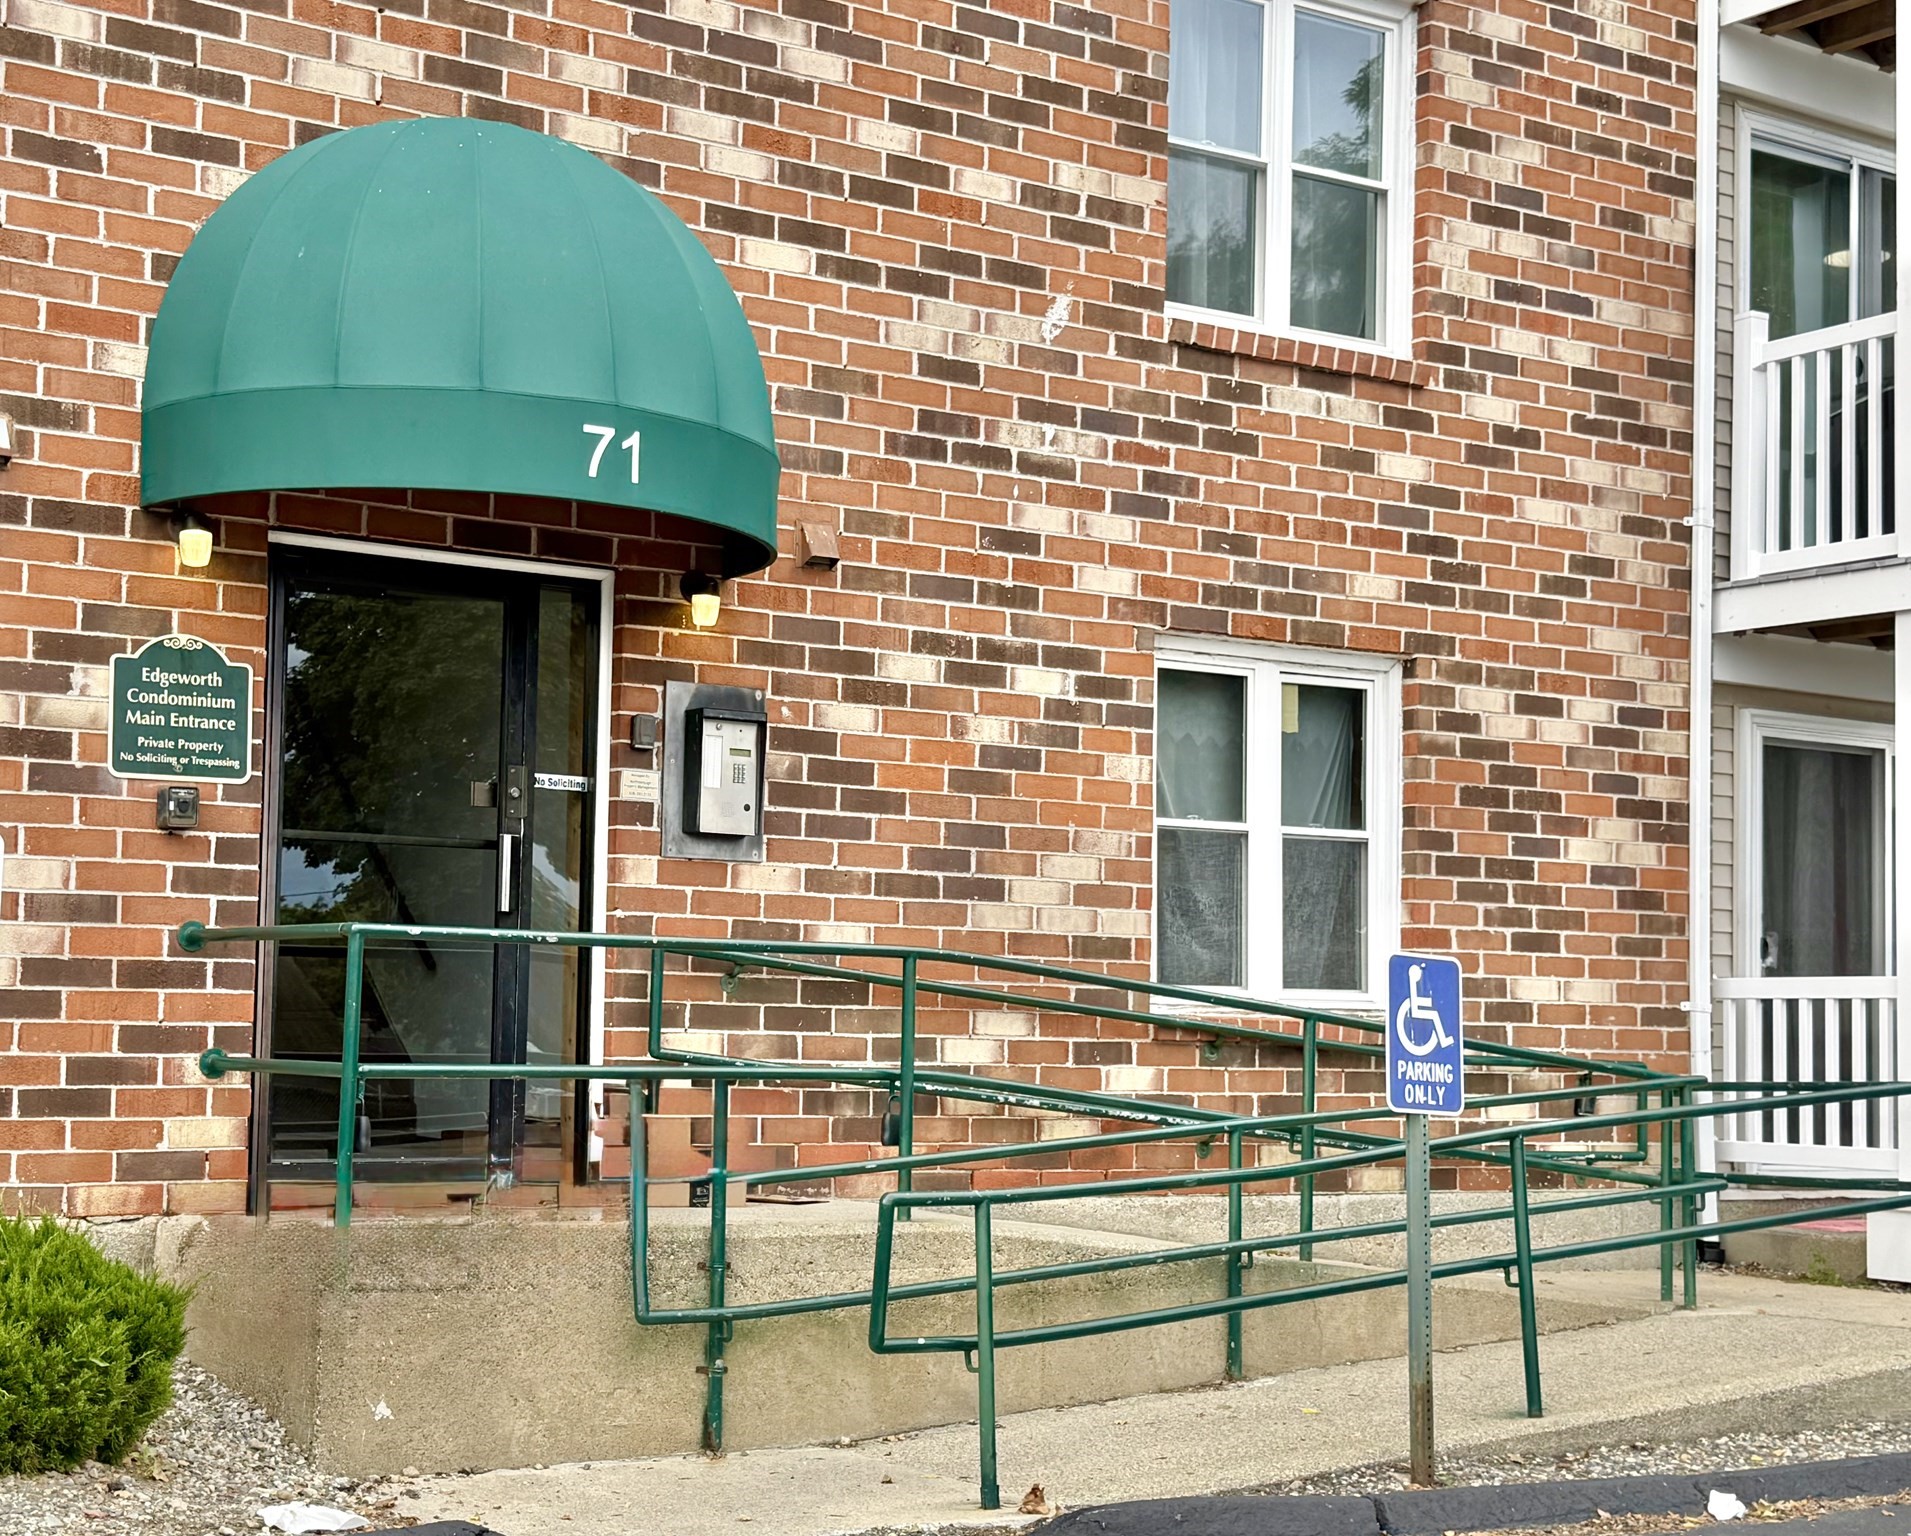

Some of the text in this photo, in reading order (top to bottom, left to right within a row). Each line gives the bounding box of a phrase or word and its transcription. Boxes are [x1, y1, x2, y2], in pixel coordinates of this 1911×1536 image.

[582, 423, 640, 484] 71
[142, 667, 223, 688] Edgeworth
[126, 688, 236, 709] Condominium
[125, 709, 236, 731] Main Entrance
[137, 736, 224, 755] Private Property
[120, 751, 134, 761] No
[136, 752, 178, 766] Soliciting
[191, 755, 240, 770] Trespassing
[534, 776, 586, 791] No Soliciting
[1397, 1060, 1453, 1084] PARKING
[1404, 1083, 1446, 1106] ONLY
